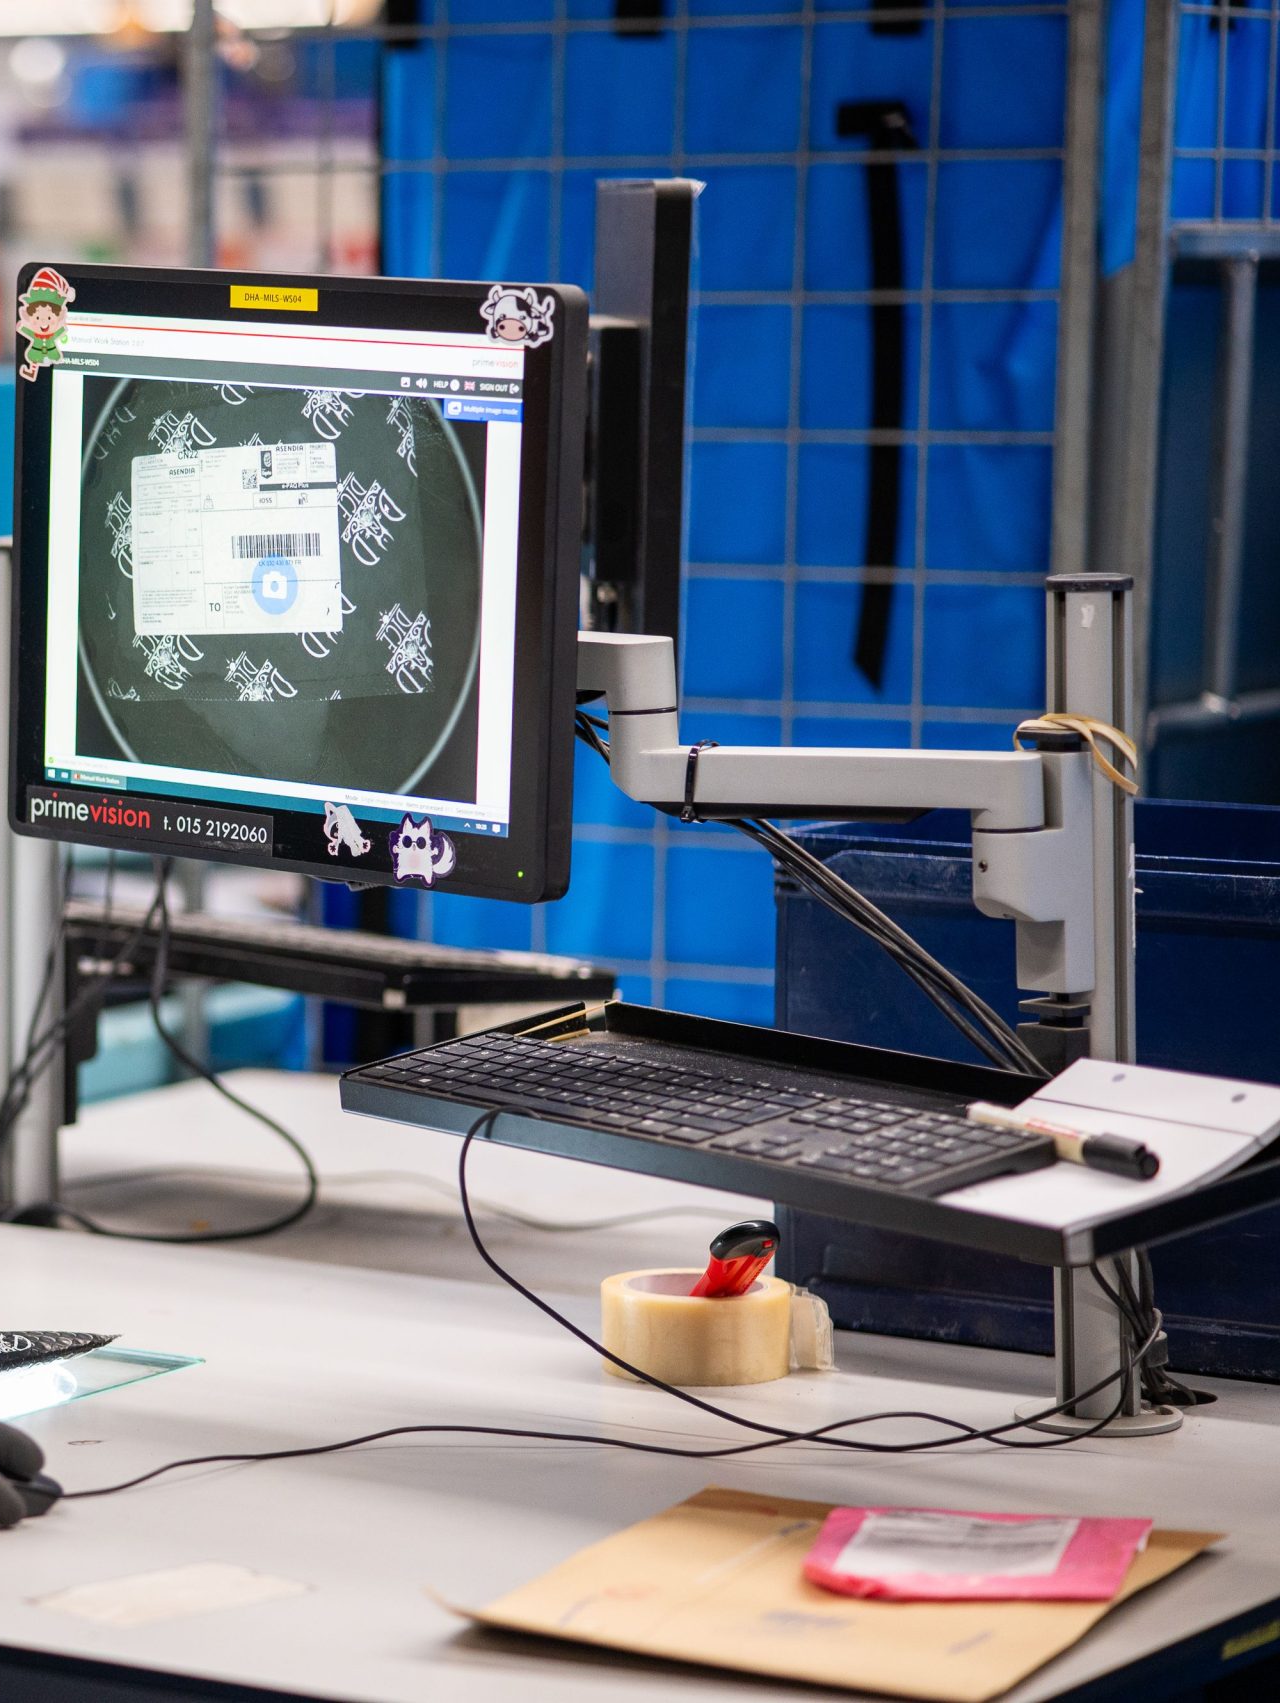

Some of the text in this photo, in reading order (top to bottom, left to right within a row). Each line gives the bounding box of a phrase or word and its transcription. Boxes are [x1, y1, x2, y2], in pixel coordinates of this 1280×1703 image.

[244, 293, 302, 303] DHA-MILS-WS04
[63, 357, 100, 367] HA-MILS-WS04
[433, 380, 449, 389] HELP
[479, 384, 508, 392] SIGN OUT
[275, 445, 304, 453] ASENDIA
[177, 450, 199, 460] CN22
[168, 467, 196, 476] ASENDIA
[209, 603, 221, 612] TO
[380, 608, 413, 654] DICE
[163, 816, 172, 831] t.
[176, 815, 201, 834] 015
[205, 819, 268, 844] 2192060
